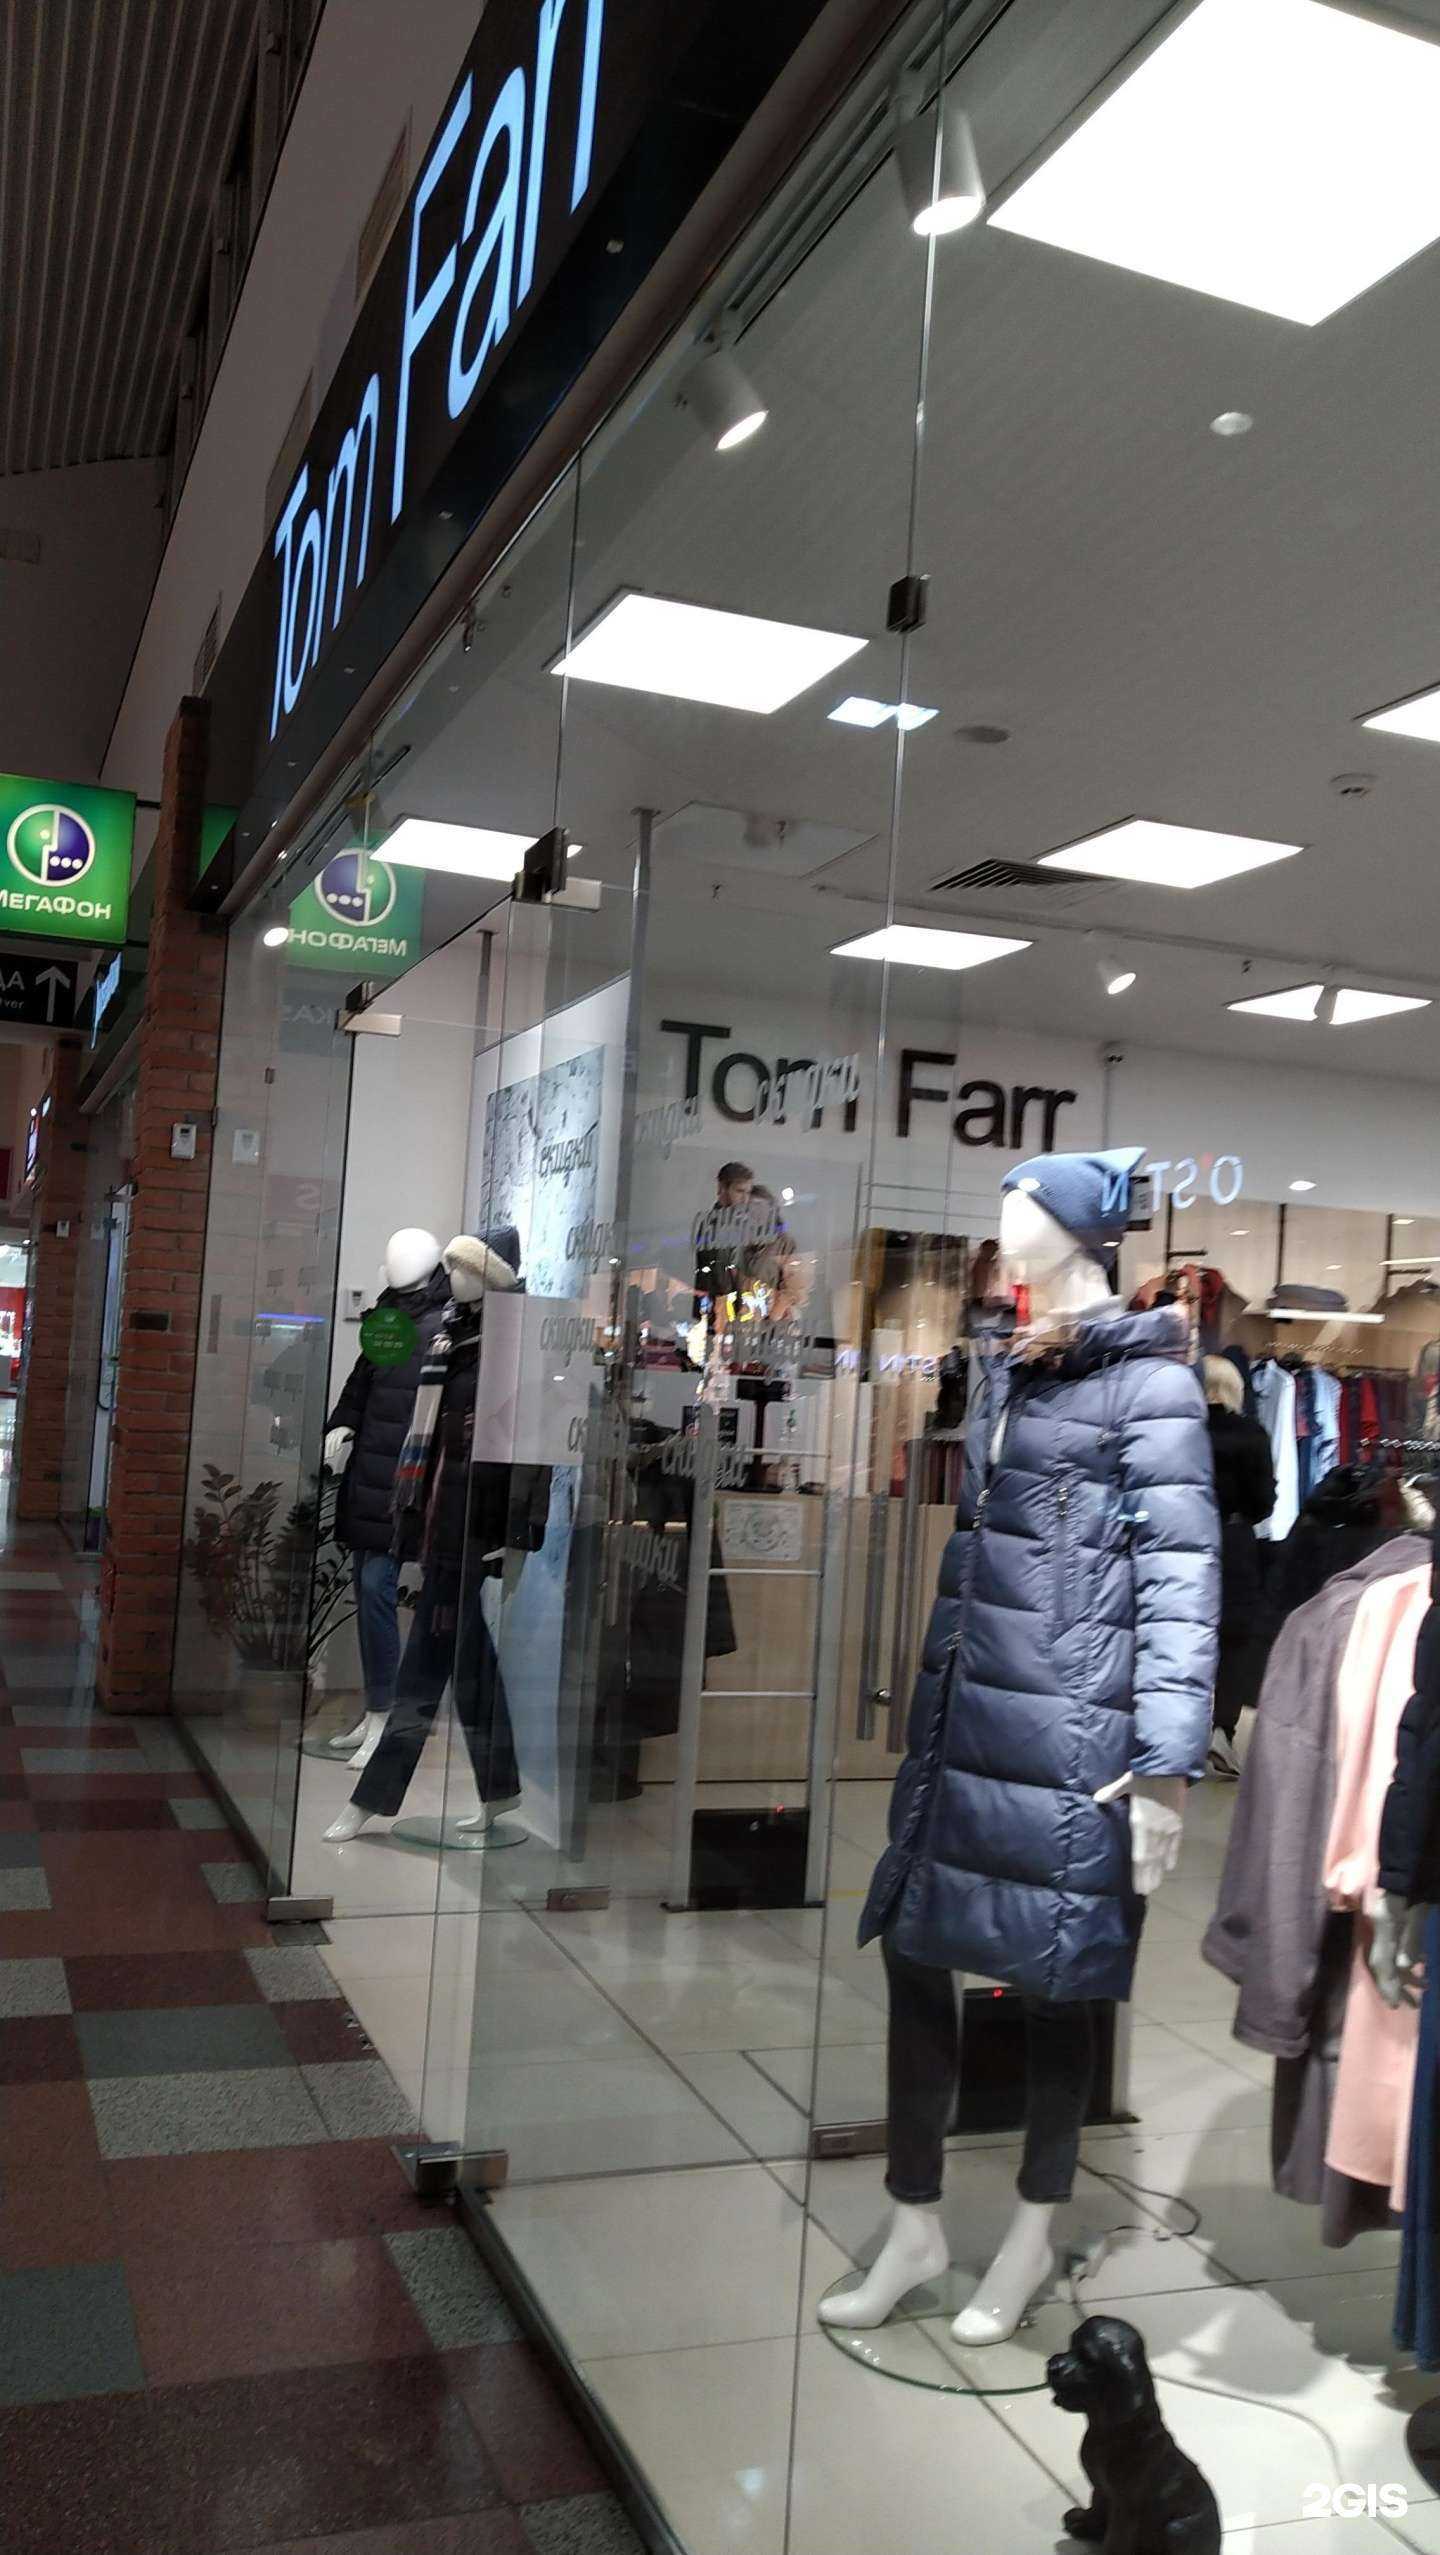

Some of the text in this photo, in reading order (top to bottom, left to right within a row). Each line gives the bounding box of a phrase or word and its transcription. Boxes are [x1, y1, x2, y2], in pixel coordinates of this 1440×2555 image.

[270, 372, 380, 742] Tom
[660, 1019, 1078, 1152] Tom Farr
